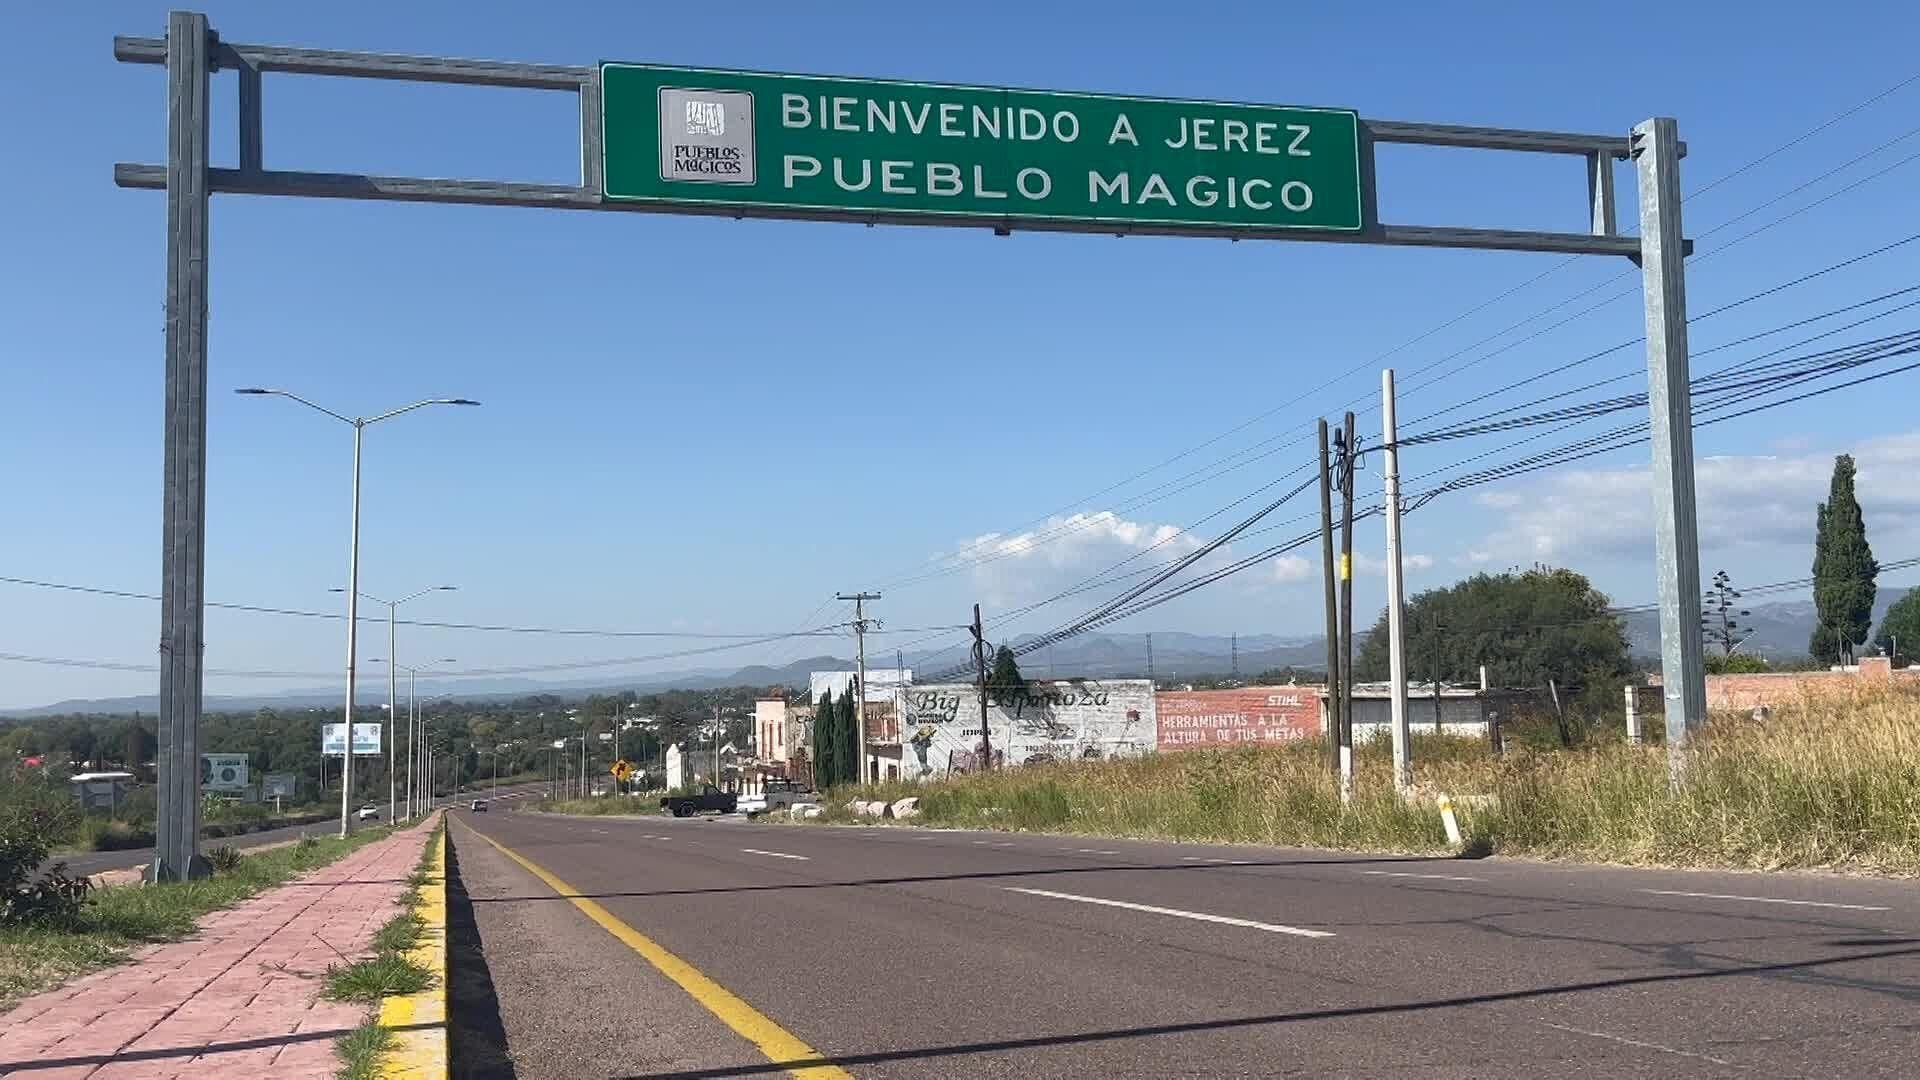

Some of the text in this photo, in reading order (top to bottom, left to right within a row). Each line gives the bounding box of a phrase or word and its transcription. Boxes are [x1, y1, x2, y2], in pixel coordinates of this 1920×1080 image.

[782, 93, 1312, 156] BIENVENIDO A JEREZ
[674, 145, 741, 160] PUEBLOS
[783, 154, 1314, 212] PUEBLO MAGICO
[1267, 694, 1303, 706] STIHL
[1162, 713, 1288, 729] HERRAMIENTAS A LA
[1163, 727, 1304, 744] ALTURA DE TUS METAS
